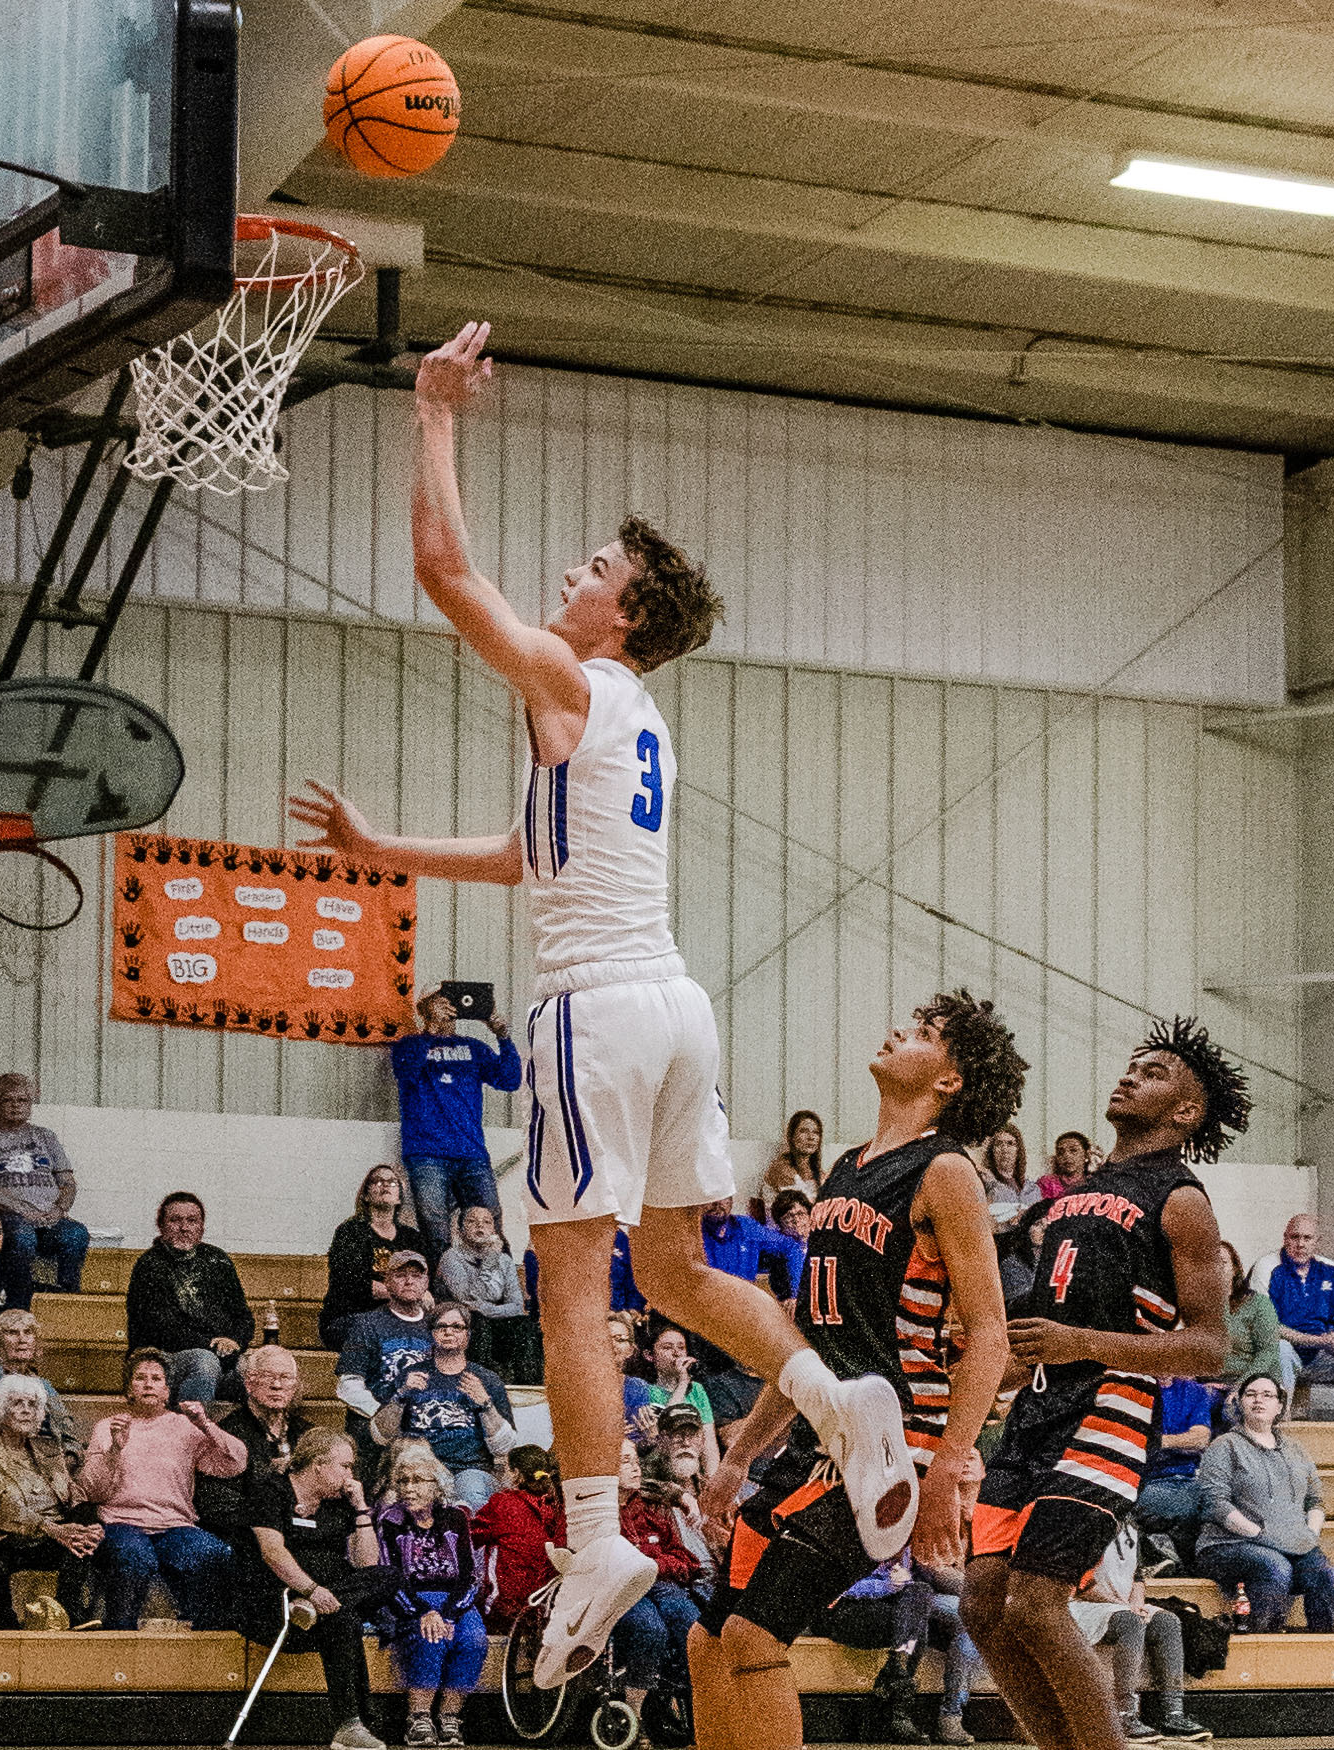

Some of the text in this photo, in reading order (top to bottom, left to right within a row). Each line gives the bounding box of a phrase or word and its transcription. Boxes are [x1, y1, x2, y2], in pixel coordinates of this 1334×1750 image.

[404, 95, 459, 119] ilson
[630, 728, 664, 832] 3
[323, 900, 357, 916] Have
[247, 926, 284, 939] Hands
[171, 958, 209, 979] BIG
[810, 1195, 894, 1256] WPORT
[809, 1255, 844, 1326] 11
[1049, 1238, 1079, 1304] 4
